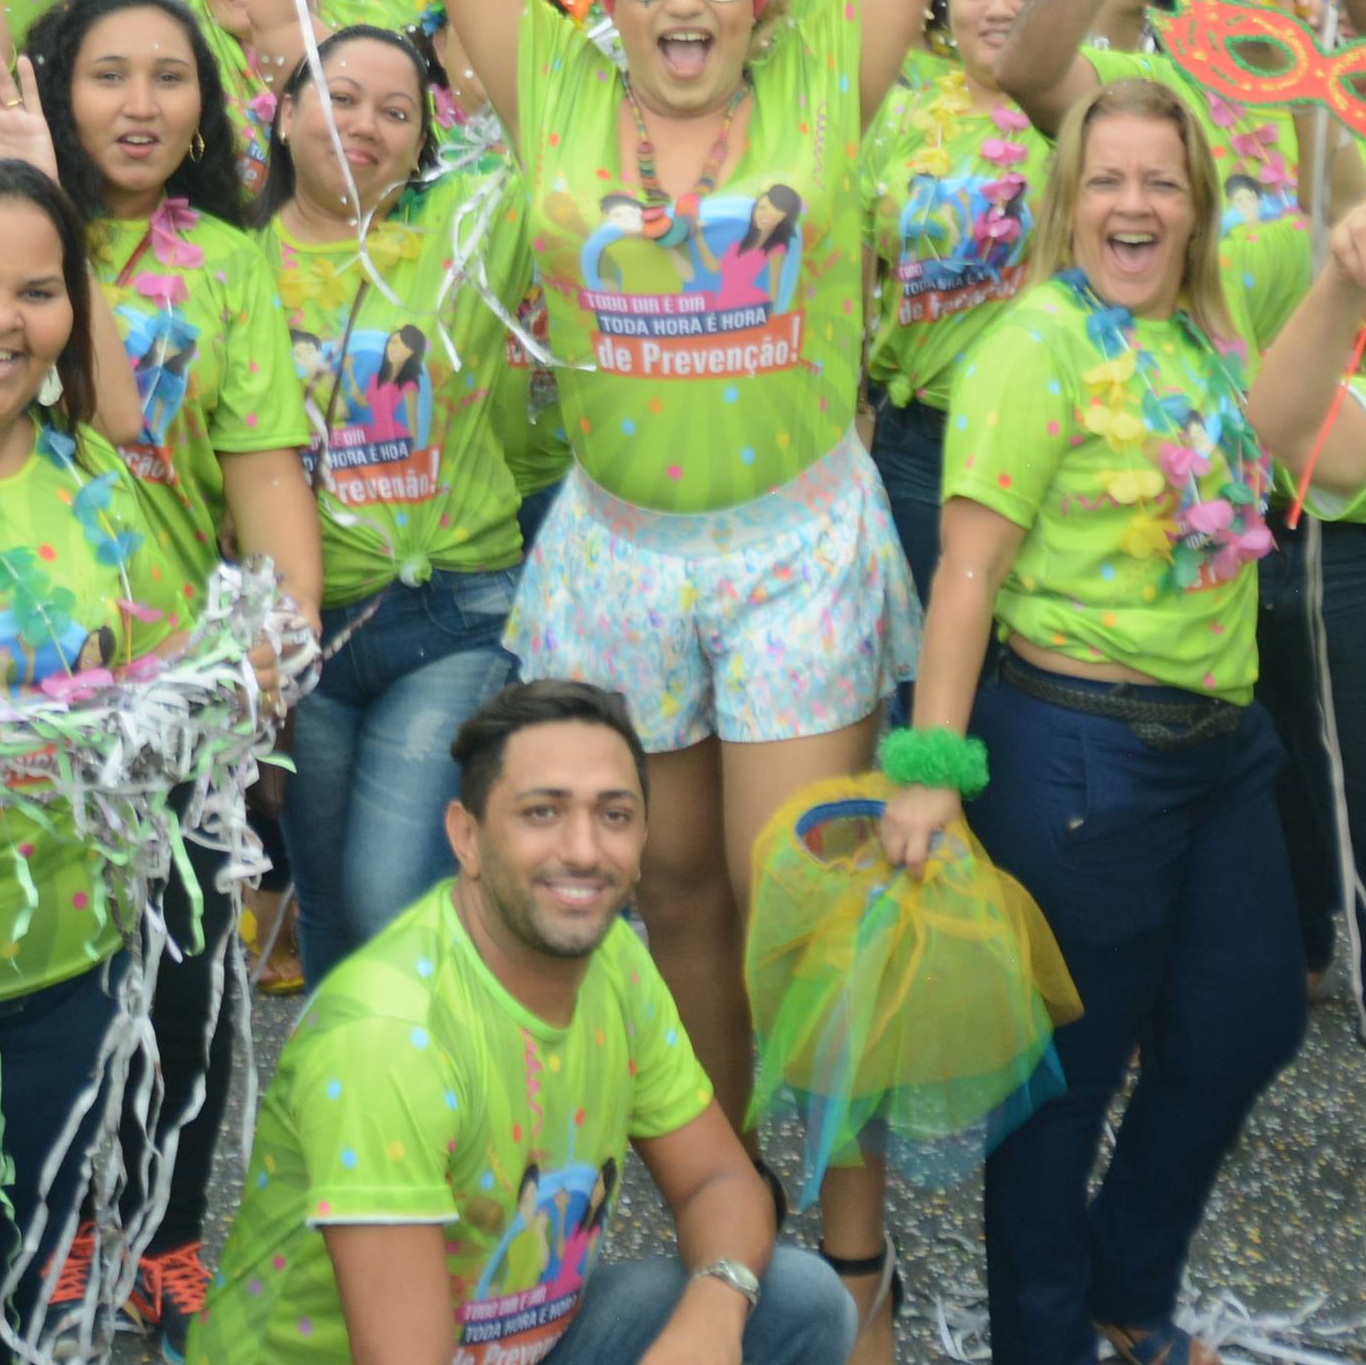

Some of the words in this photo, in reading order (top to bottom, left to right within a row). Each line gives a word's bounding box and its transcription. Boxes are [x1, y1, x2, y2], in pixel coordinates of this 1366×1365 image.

[584, 292, 627, 313] TODO
[600, 315, 649, 335] TODA
[654, 316, 703, 336] HORA
[722, 307, 767, 328] HORA
[598, 337, 633, 373] de
[640, 315, 801, 378] Prevenção!
[465, 1321, 502, 1343] TODA
[504, 1310, 537, 1335] HORA
